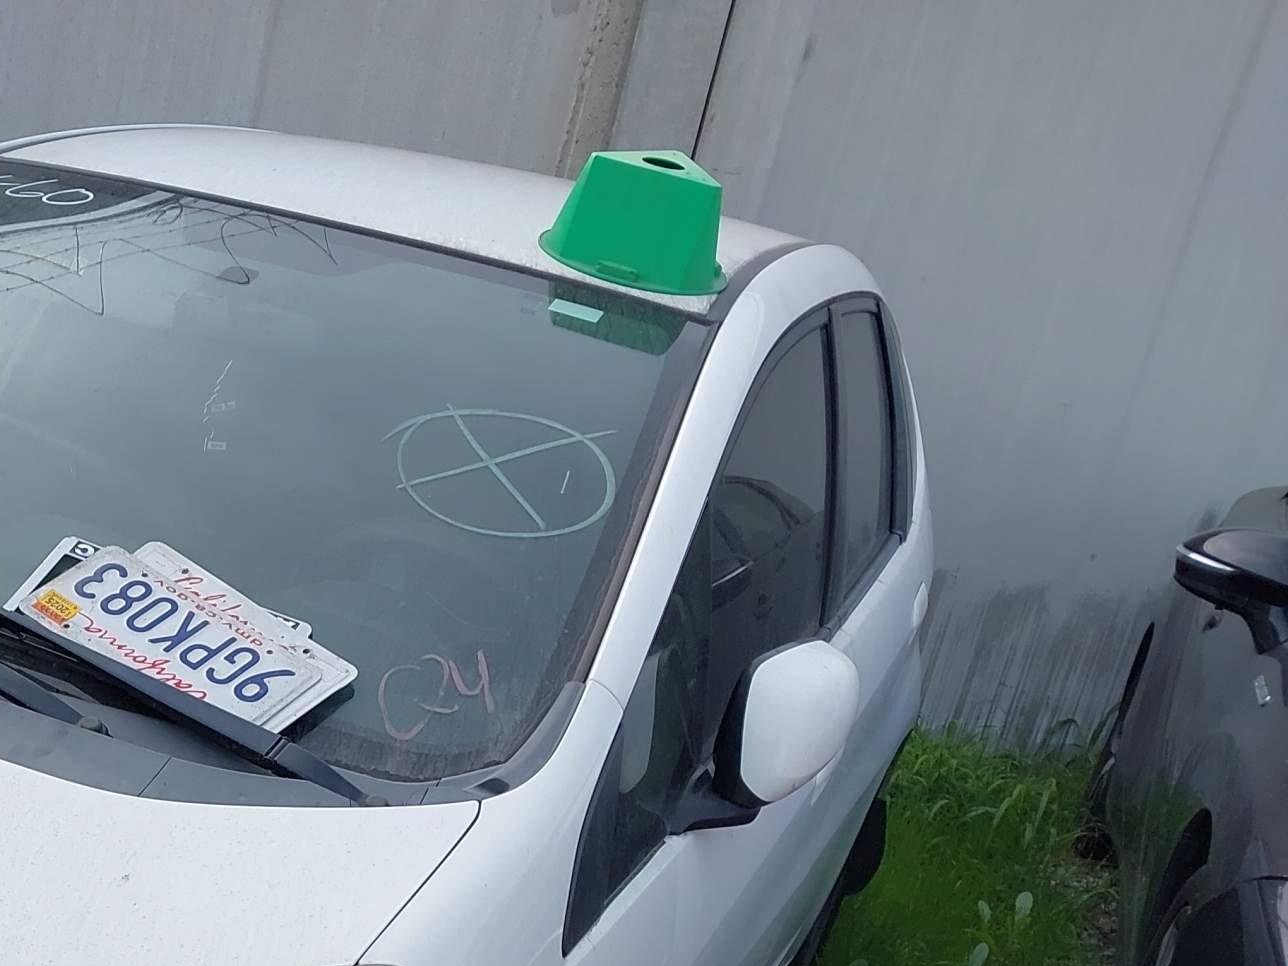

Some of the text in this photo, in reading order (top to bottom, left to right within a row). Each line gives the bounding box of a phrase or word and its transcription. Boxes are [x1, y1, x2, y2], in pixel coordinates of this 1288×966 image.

[44, 597, 70, 614] 2025
[74, 563, 296, 703] 9GPK083
[153, 579, 264, 647] dmv.ca.gov
